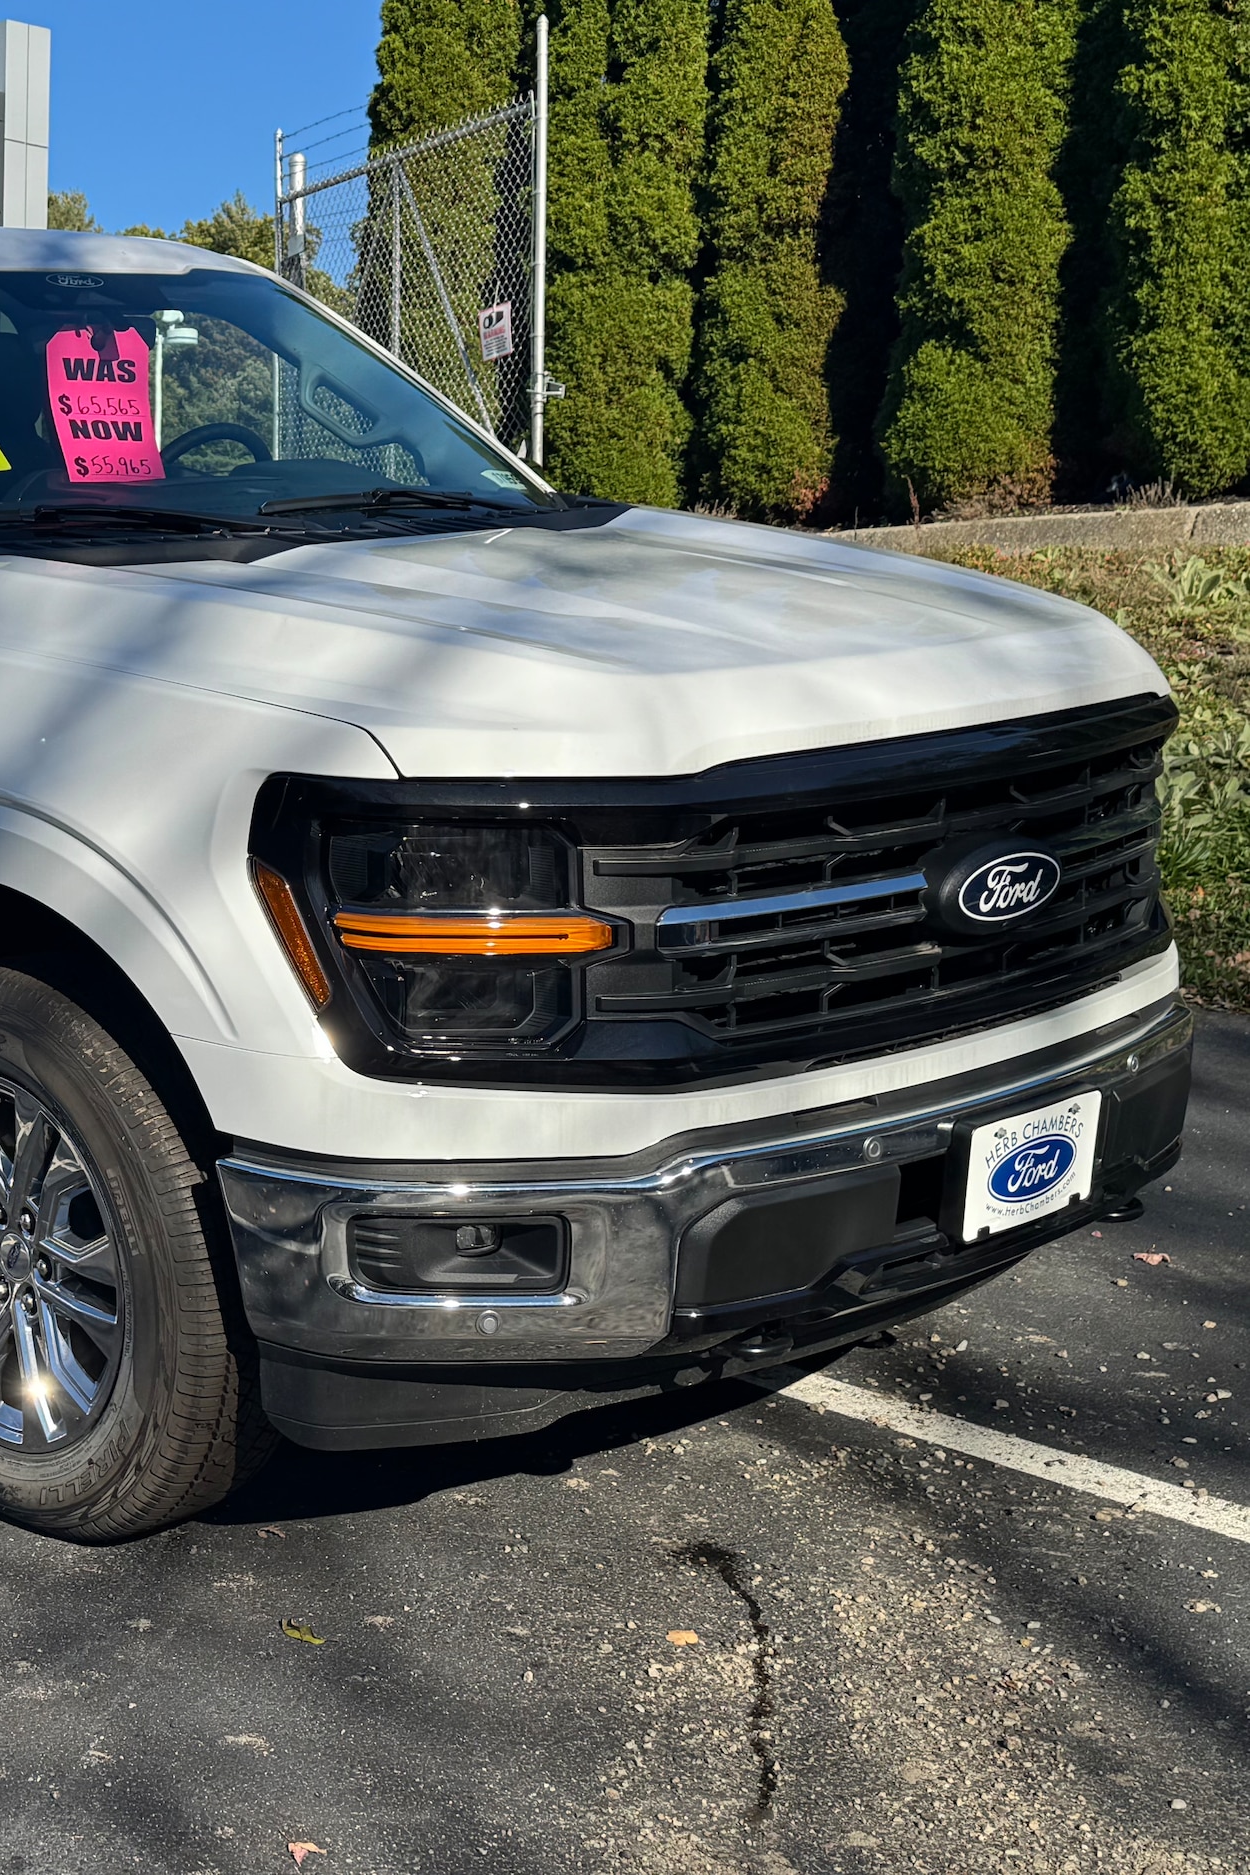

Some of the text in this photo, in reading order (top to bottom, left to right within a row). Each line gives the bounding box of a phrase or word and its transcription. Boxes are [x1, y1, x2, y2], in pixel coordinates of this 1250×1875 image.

[57, 275, 95, 286] Ford
[62, 357, 137, 383] WAS
[68, 418, 143, 442] NOW
[74, 455, 152, 478] $55,965
[978, 861, 1044, 914] Ford
[984, 1114, 1084, 1170] HERB CHAMBERS
[1007, 1144, 1062, 1193] Ford
[985, 1171, 1077, 1217] www.HerbChambers.com
[39, 1417, 132, 1505] PIRELLI
